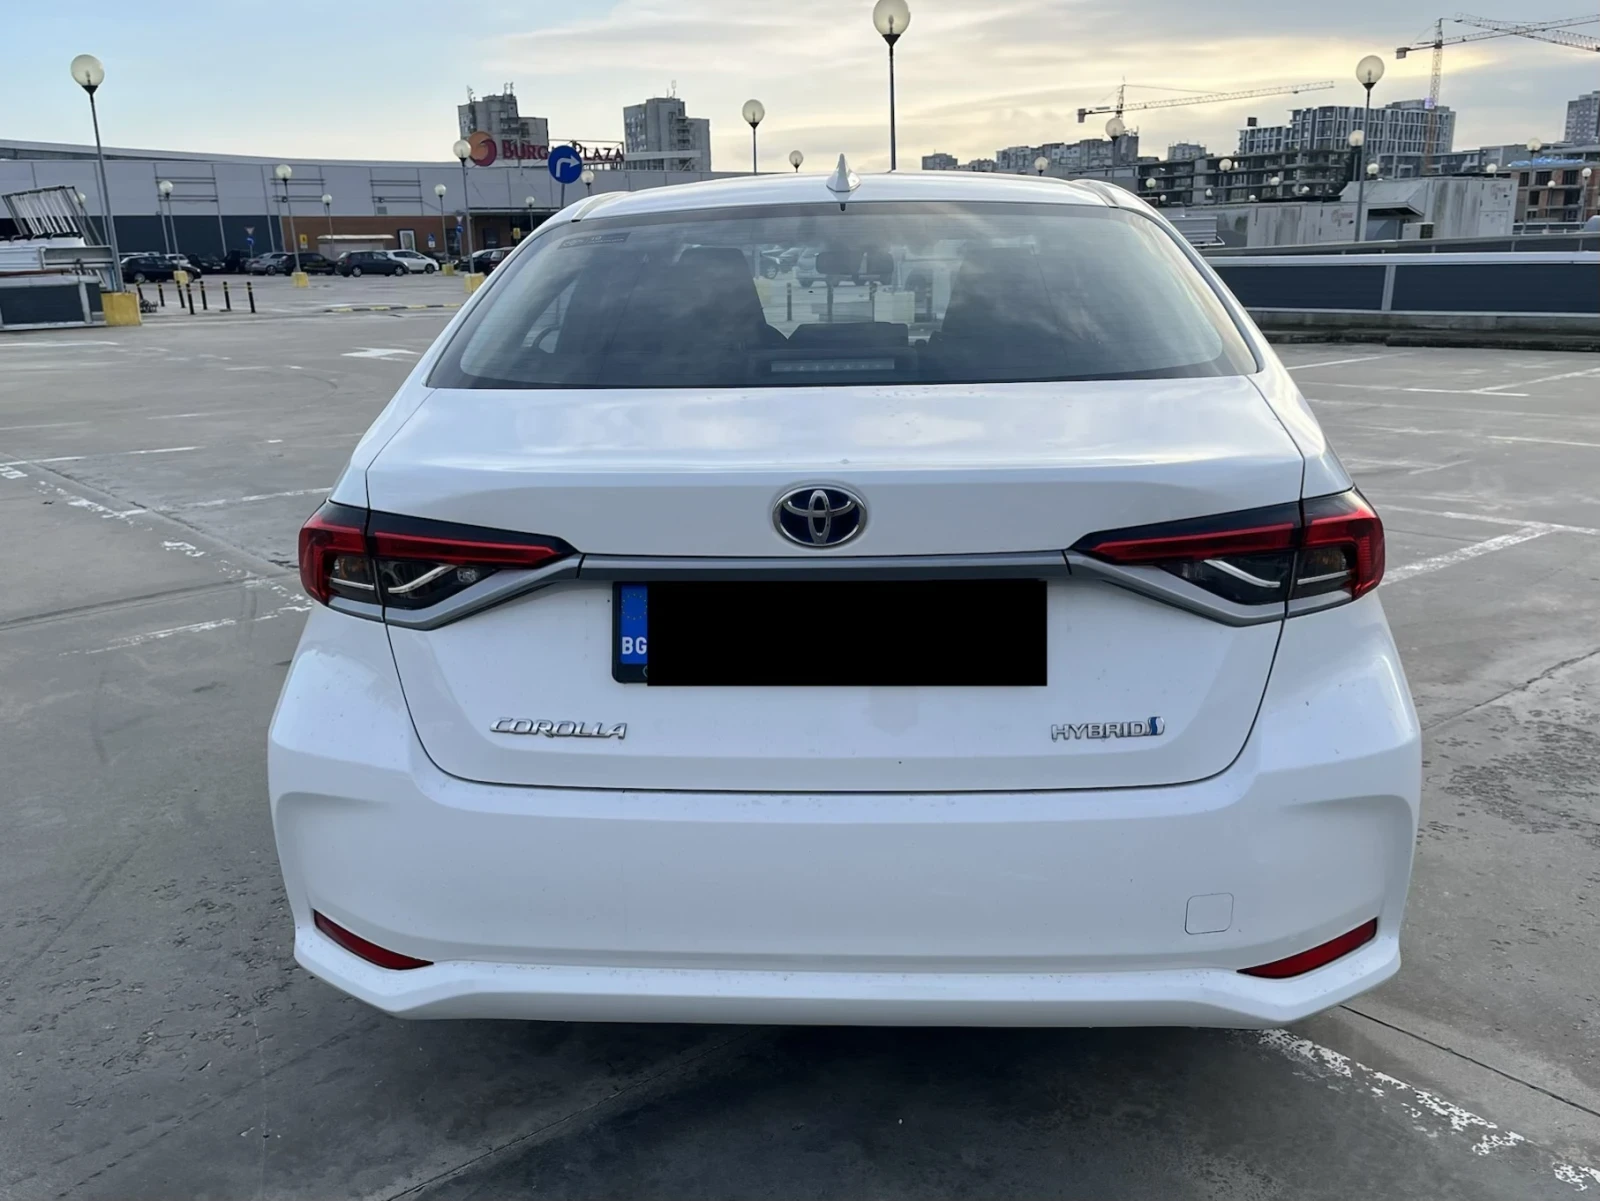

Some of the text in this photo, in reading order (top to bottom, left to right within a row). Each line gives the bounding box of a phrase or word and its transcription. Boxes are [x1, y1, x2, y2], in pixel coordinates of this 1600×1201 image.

[502, 139, 624, 162] BURG PLAZA
[622, 636, 647, 655] BG
[490, 717, 627, 740] COROLLA
[1051, 721, 1147, 740] HYBRID
